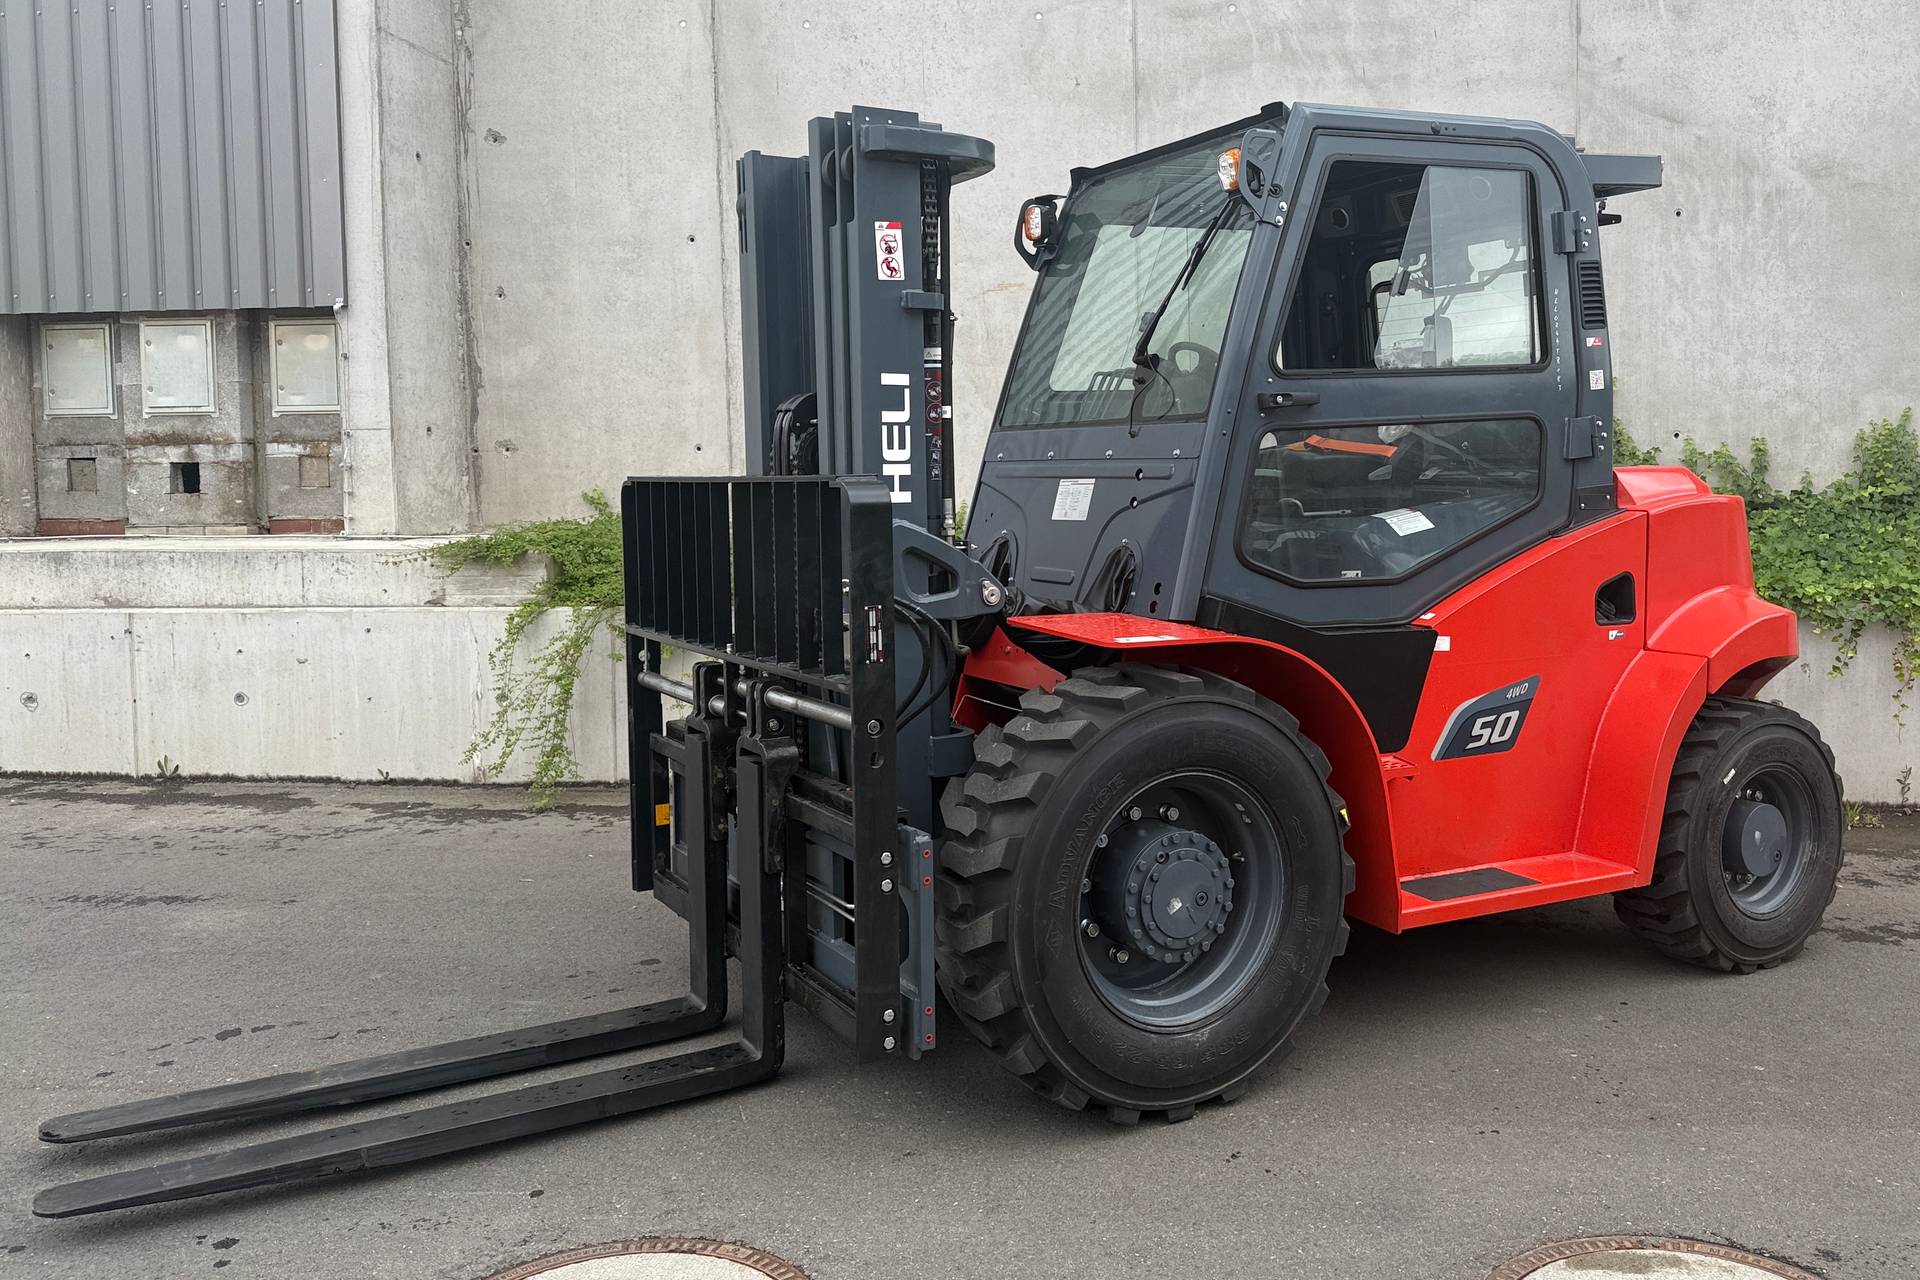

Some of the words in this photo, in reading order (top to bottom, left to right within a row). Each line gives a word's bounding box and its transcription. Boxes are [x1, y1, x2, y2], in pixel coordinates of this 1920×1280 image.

[881, 372, 912, 503] HELI
[1506, 682, 1529, 699] 4WD
[1465, 710, 1520, 750] 50
